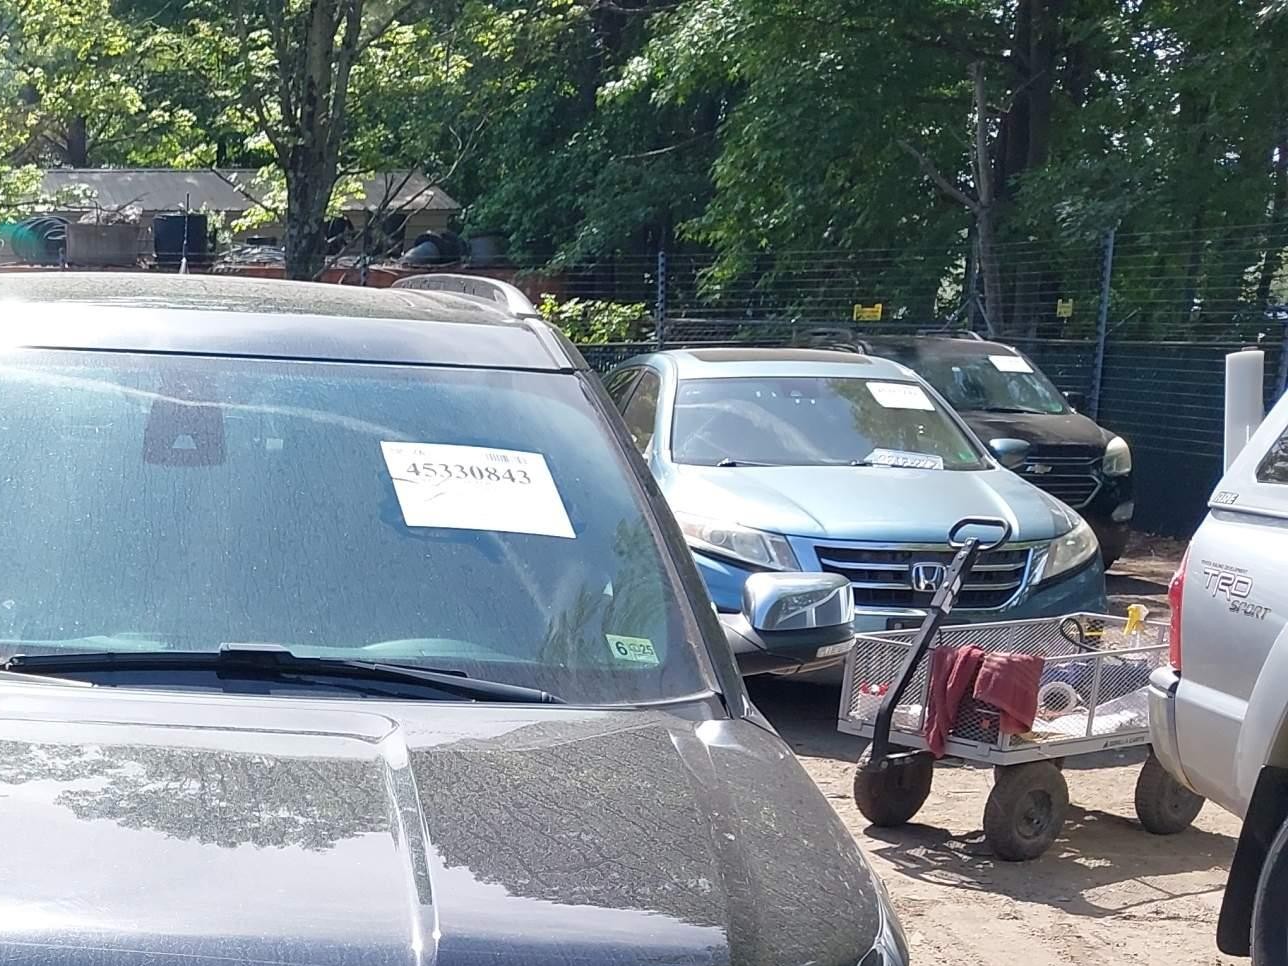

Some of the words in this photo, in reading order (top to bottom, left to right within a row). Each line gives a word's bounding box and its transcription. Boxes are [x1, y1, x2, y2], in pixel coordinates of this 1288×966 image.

[406, 461, 531, 485] 45330843
[1203, 567, 1254, 602] TRD
[1228, 600, 1272, 621] SPORT
[615, 641, 628, 656] 6
